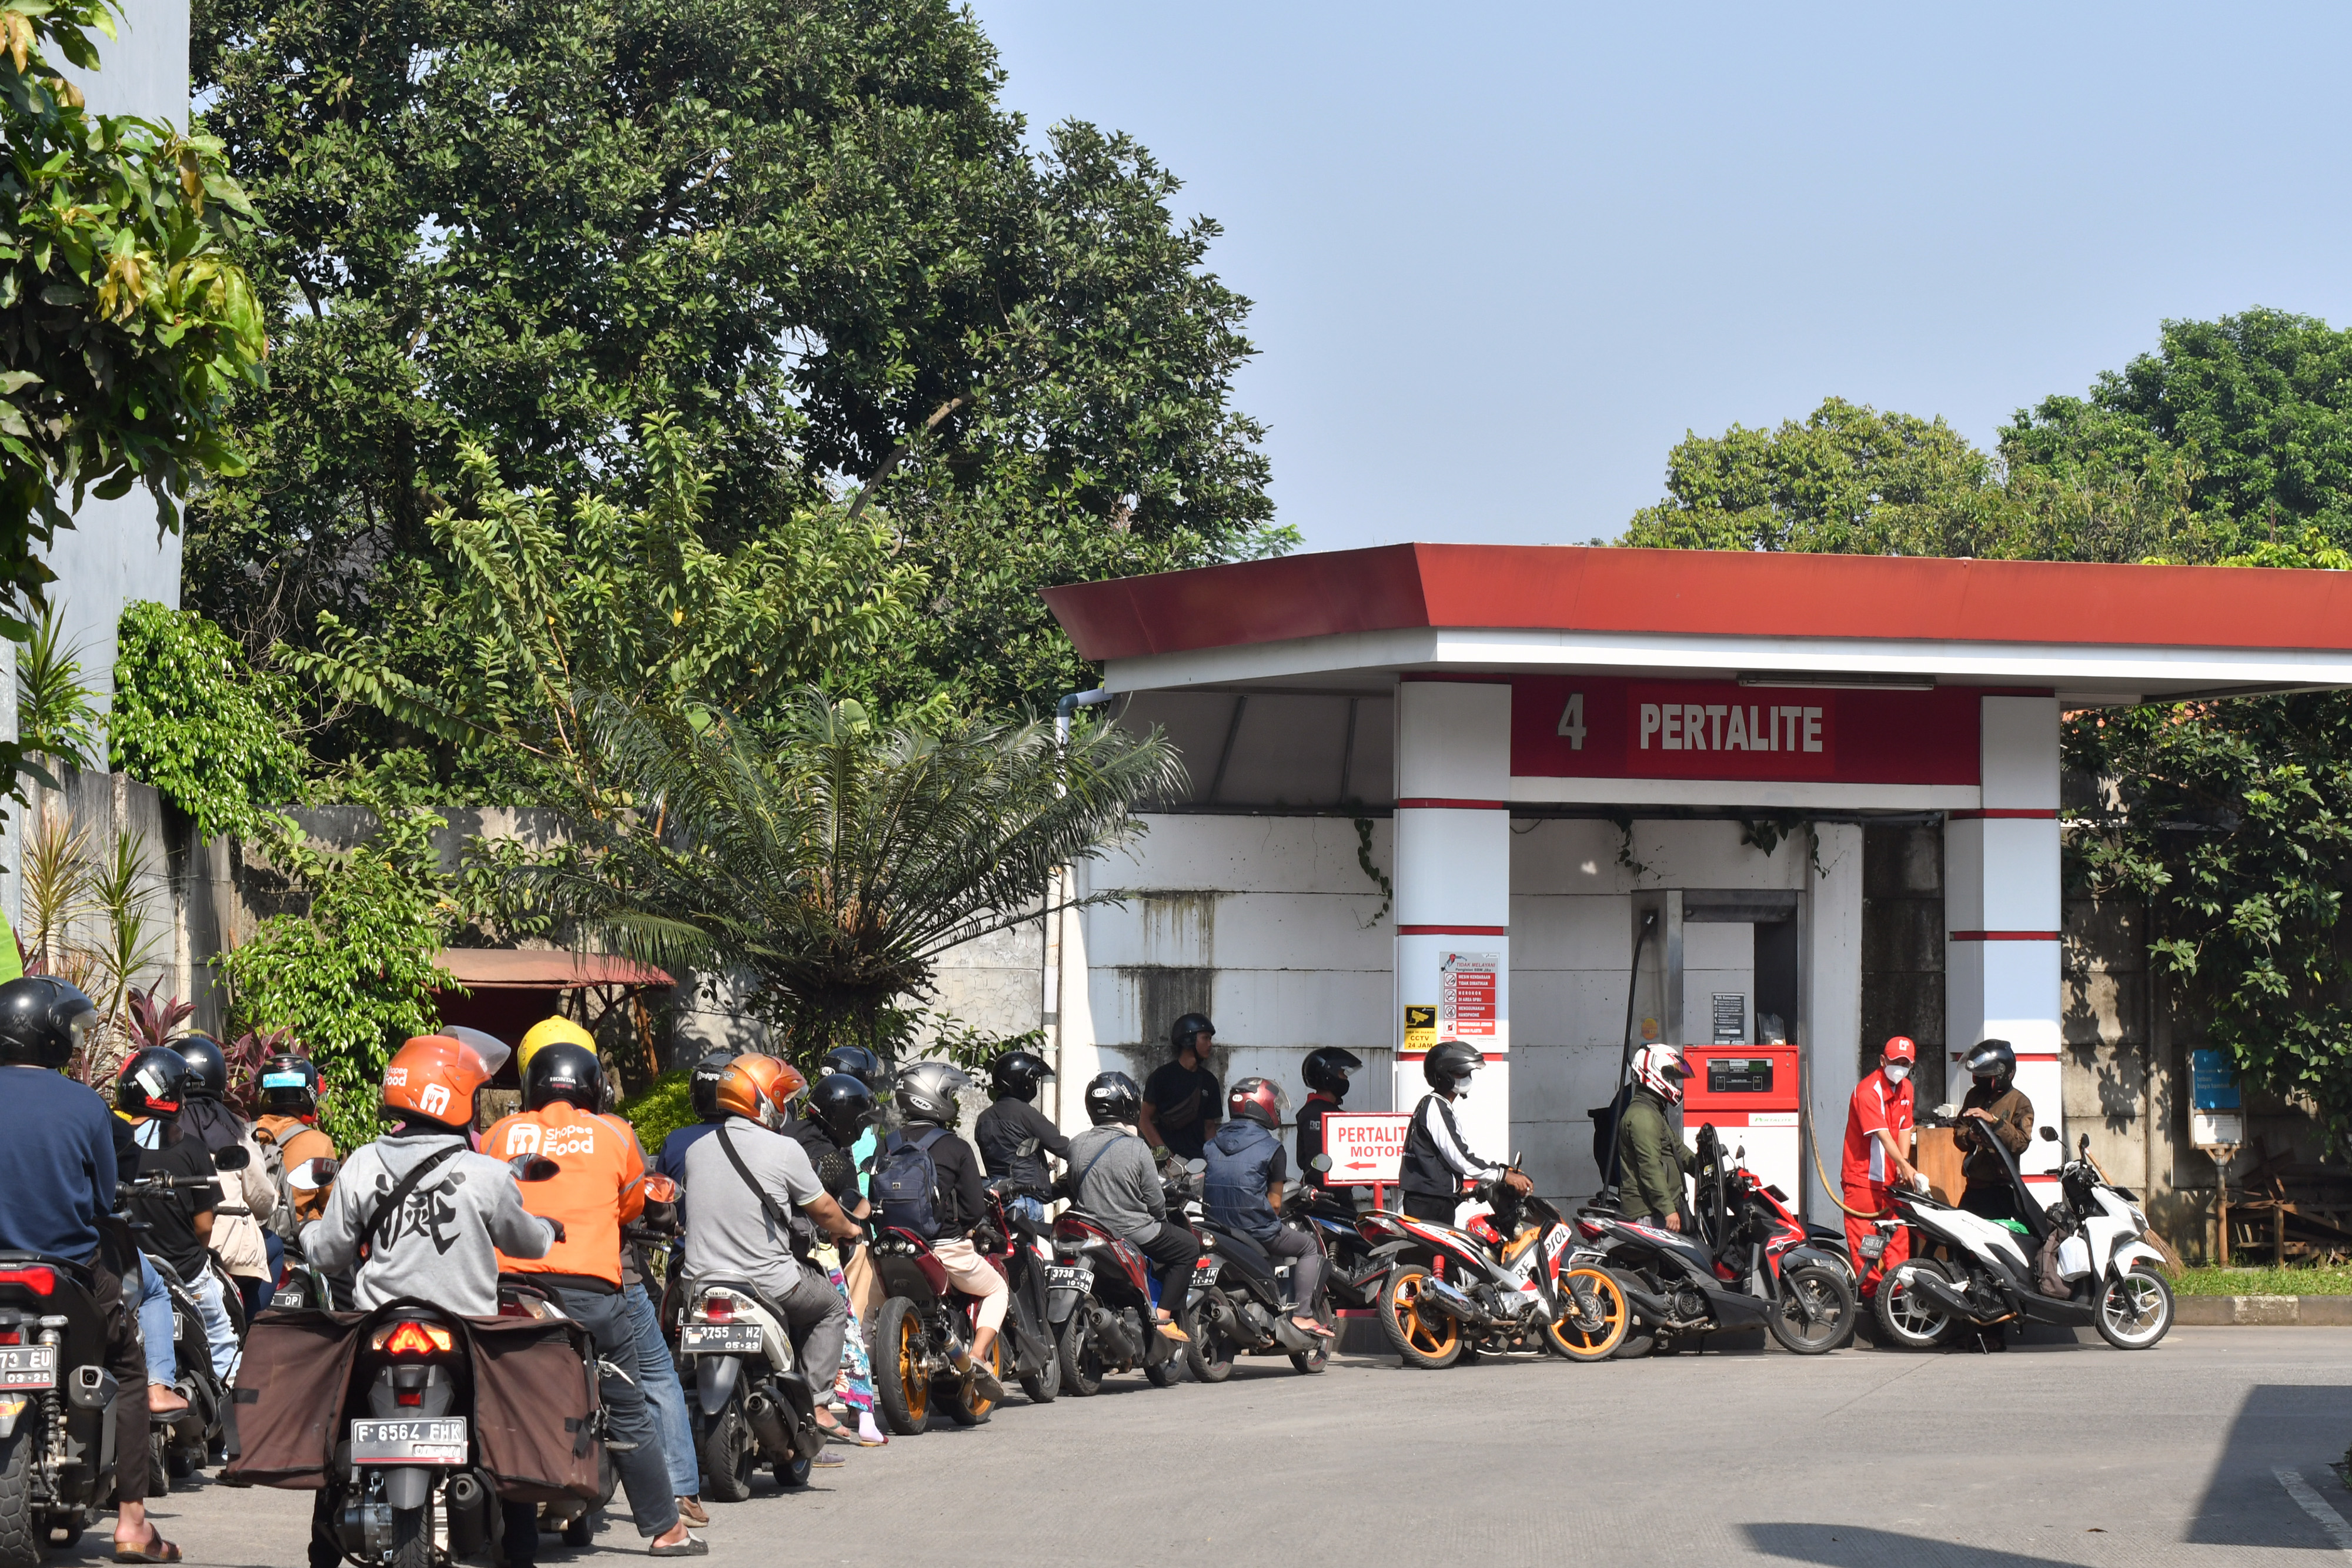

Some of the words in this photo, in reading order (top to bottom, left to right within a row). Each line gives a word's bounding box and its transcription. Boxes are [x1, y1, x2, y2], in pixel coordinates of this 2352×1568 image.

[1558, 693, 1587, 750] 4
[1641, 704, 1822, 753] PERTALITE
[912, 1098, 930, 1108] INK
[545, 1125, 593, 1141] Shopee
[1338, 1126, 1406, 1142] PERTALIT
[542, 1135, 594, 1156] Food
[1351, 1146, 1404, 1157] MOTOR
[1052, 1269, 1075, 1278] 3738
[285, 1296, 298, 1306] DP
[746, 1326, 760, 1338] HZ
[29, 1351, 50, 1368] EU
[378, 1423, 420, 1441] 6564
